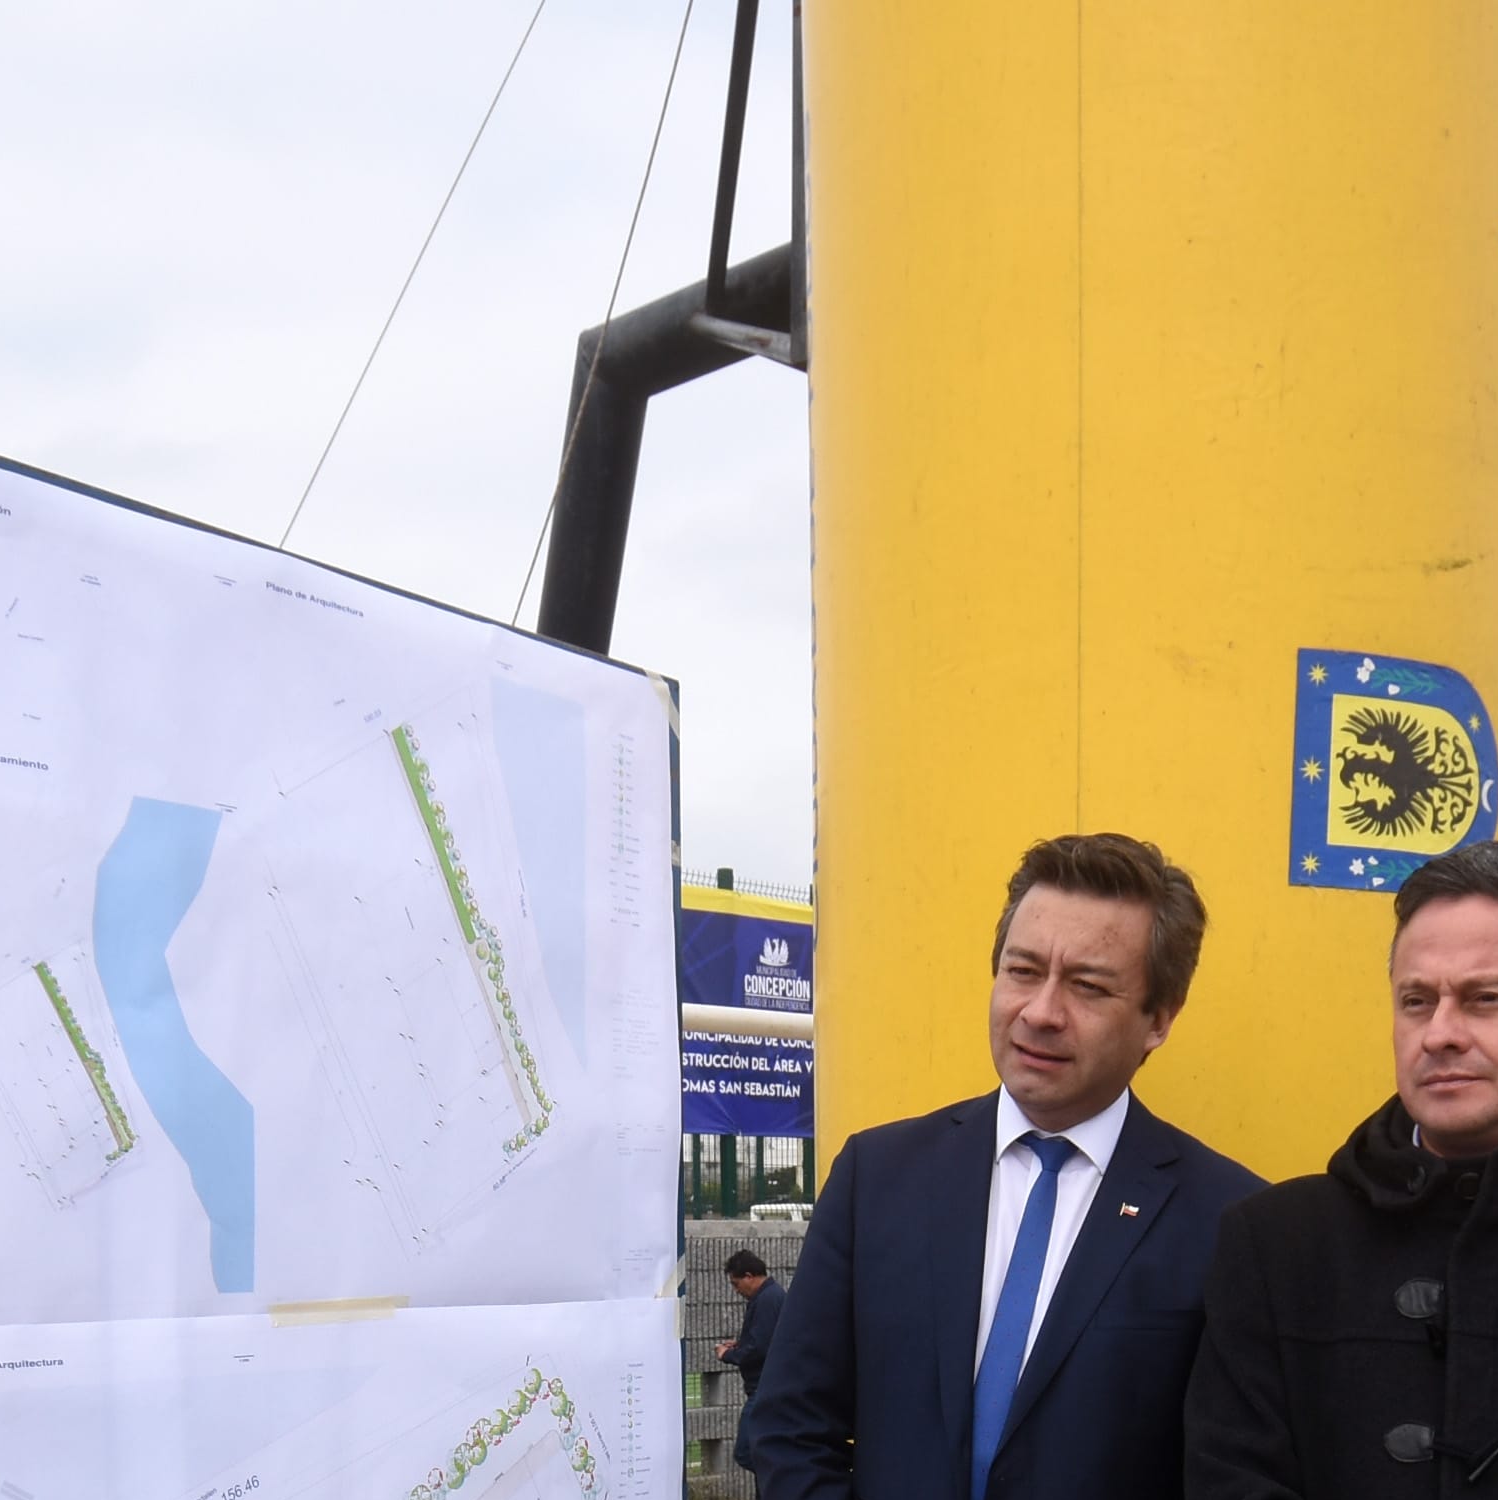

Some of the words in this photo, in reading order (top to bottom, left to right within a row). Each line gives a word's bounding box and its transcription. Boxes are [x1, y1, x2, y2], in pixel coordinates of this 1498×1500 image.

[265, 581, 293, 596] Plano
[295, 590, 307, 600] de
[309, 594, 365, 618] Arquitectura
[744, 974, 811, 1000] CONCEPCIÓN
[682, 1031, 762, 1045] UNICIPALIDAD
[751, 1056, 771, 1072] DEL
[773, 1054, 802, 1073] ÁREA
[719, 1080, 742, 1095] SAN
[744, 1081, 801, 1098] SEBASTIÁN
